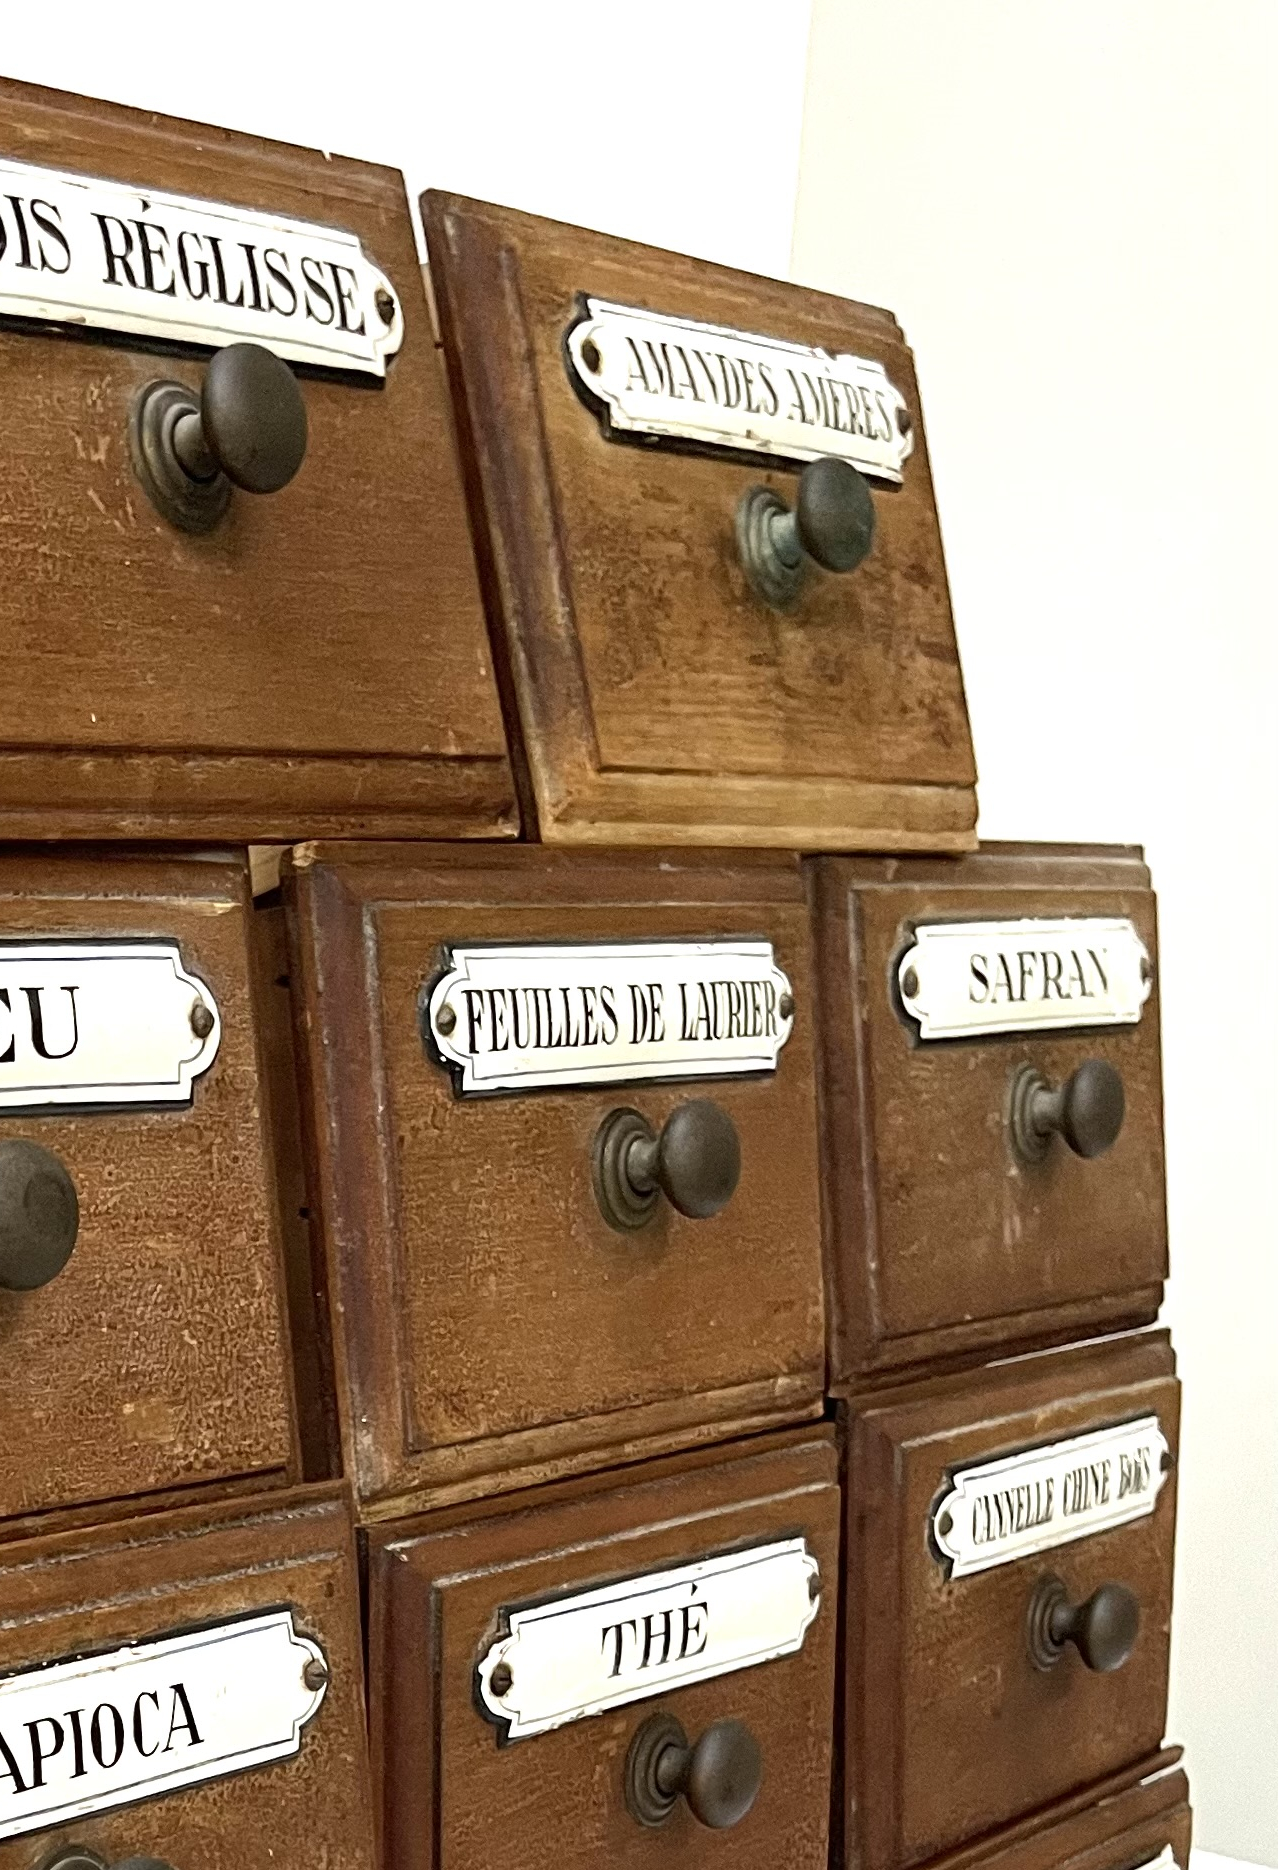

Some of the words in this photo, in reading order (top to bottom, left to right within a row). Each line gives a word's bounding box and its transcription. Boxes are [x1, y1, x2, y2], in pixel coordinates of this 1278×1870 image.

[91, 199, 366, 335] RÉGLISSE
[625, 337, 777, 417] AMANDES
[461, 985, 619, 1054] FEUILLES
[628, 983, 666, 1044] DE
[678, 980, 778, 1041] LAURIER
[969, 948, 1109, 1004] SAFRAN
[972, 1477, 1054, 1545] CANNELLE
[1063, 1459, 1111, 1517] CHINE
[601, 1582, 708, 1678] THÉ
